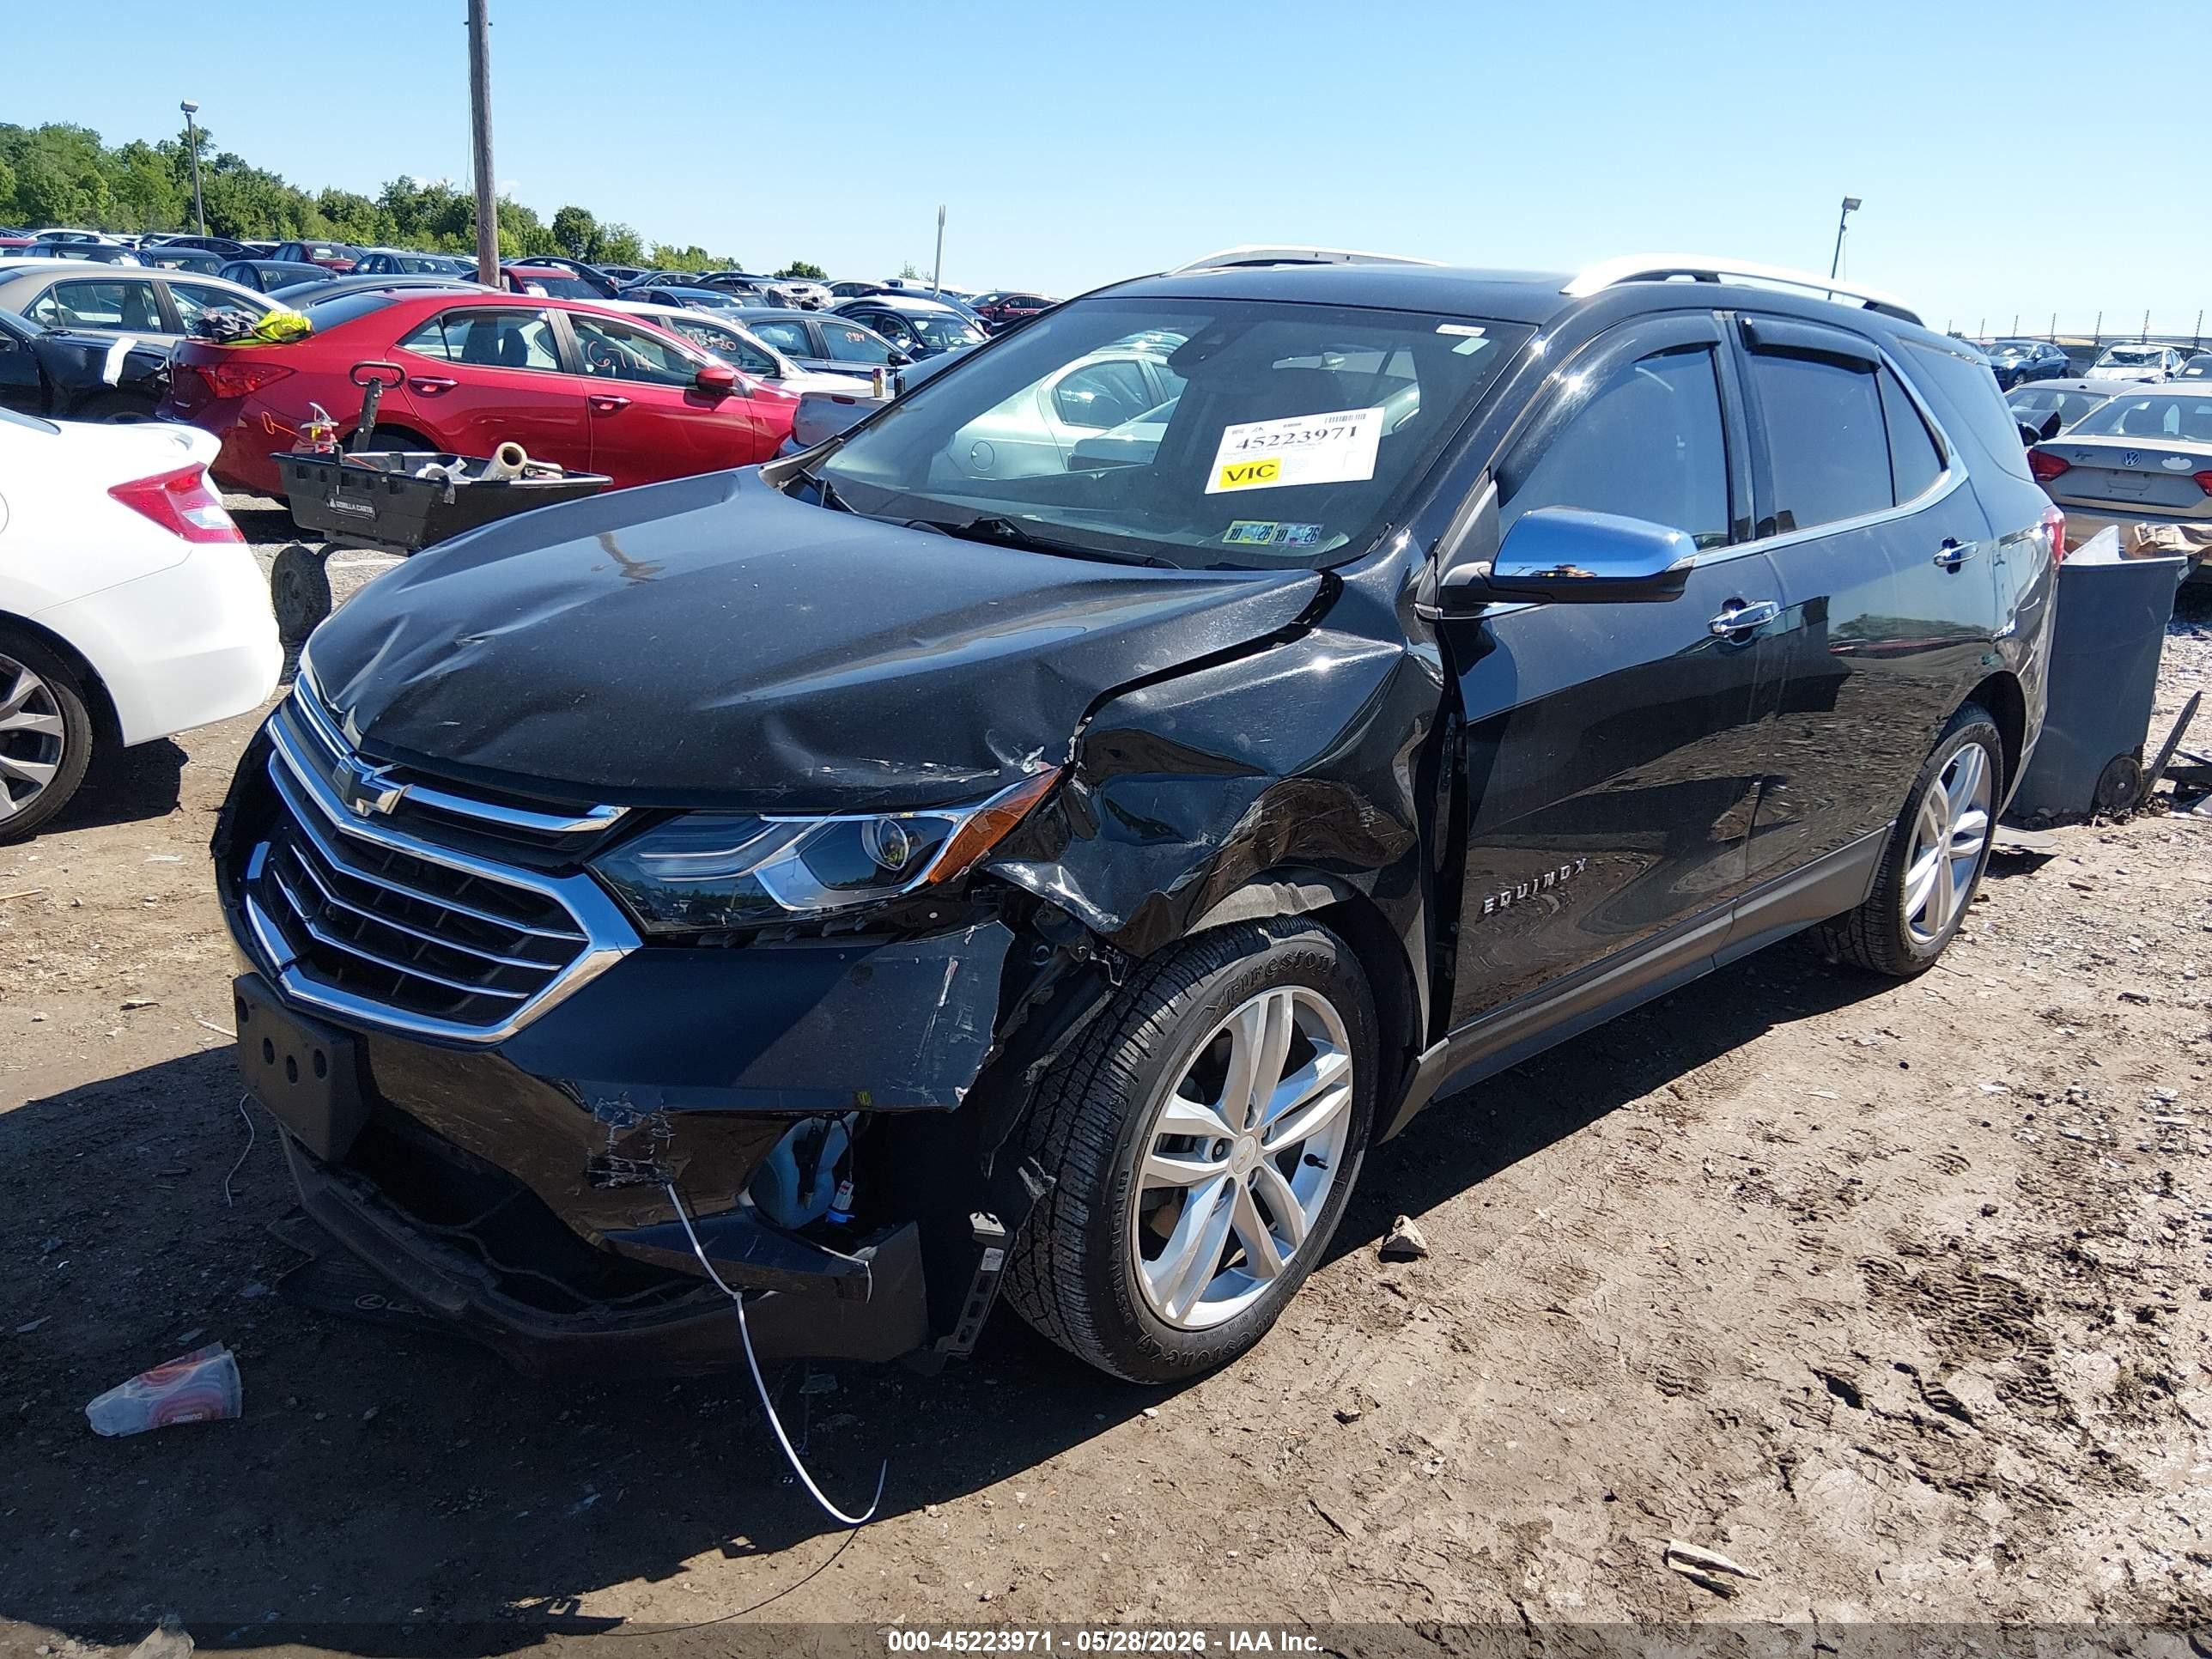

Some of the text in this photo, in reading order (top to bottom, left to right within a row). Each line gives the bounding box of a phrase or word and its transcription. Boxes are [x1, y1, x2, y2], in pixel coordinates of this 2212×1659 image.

[1236, 425, 1358, 450] 45223971
[1226, 464, 1275, 482] VIC
[1304, 526, 1320, 543] 26
[1484, 858, 1587, 915] EQUINOX
